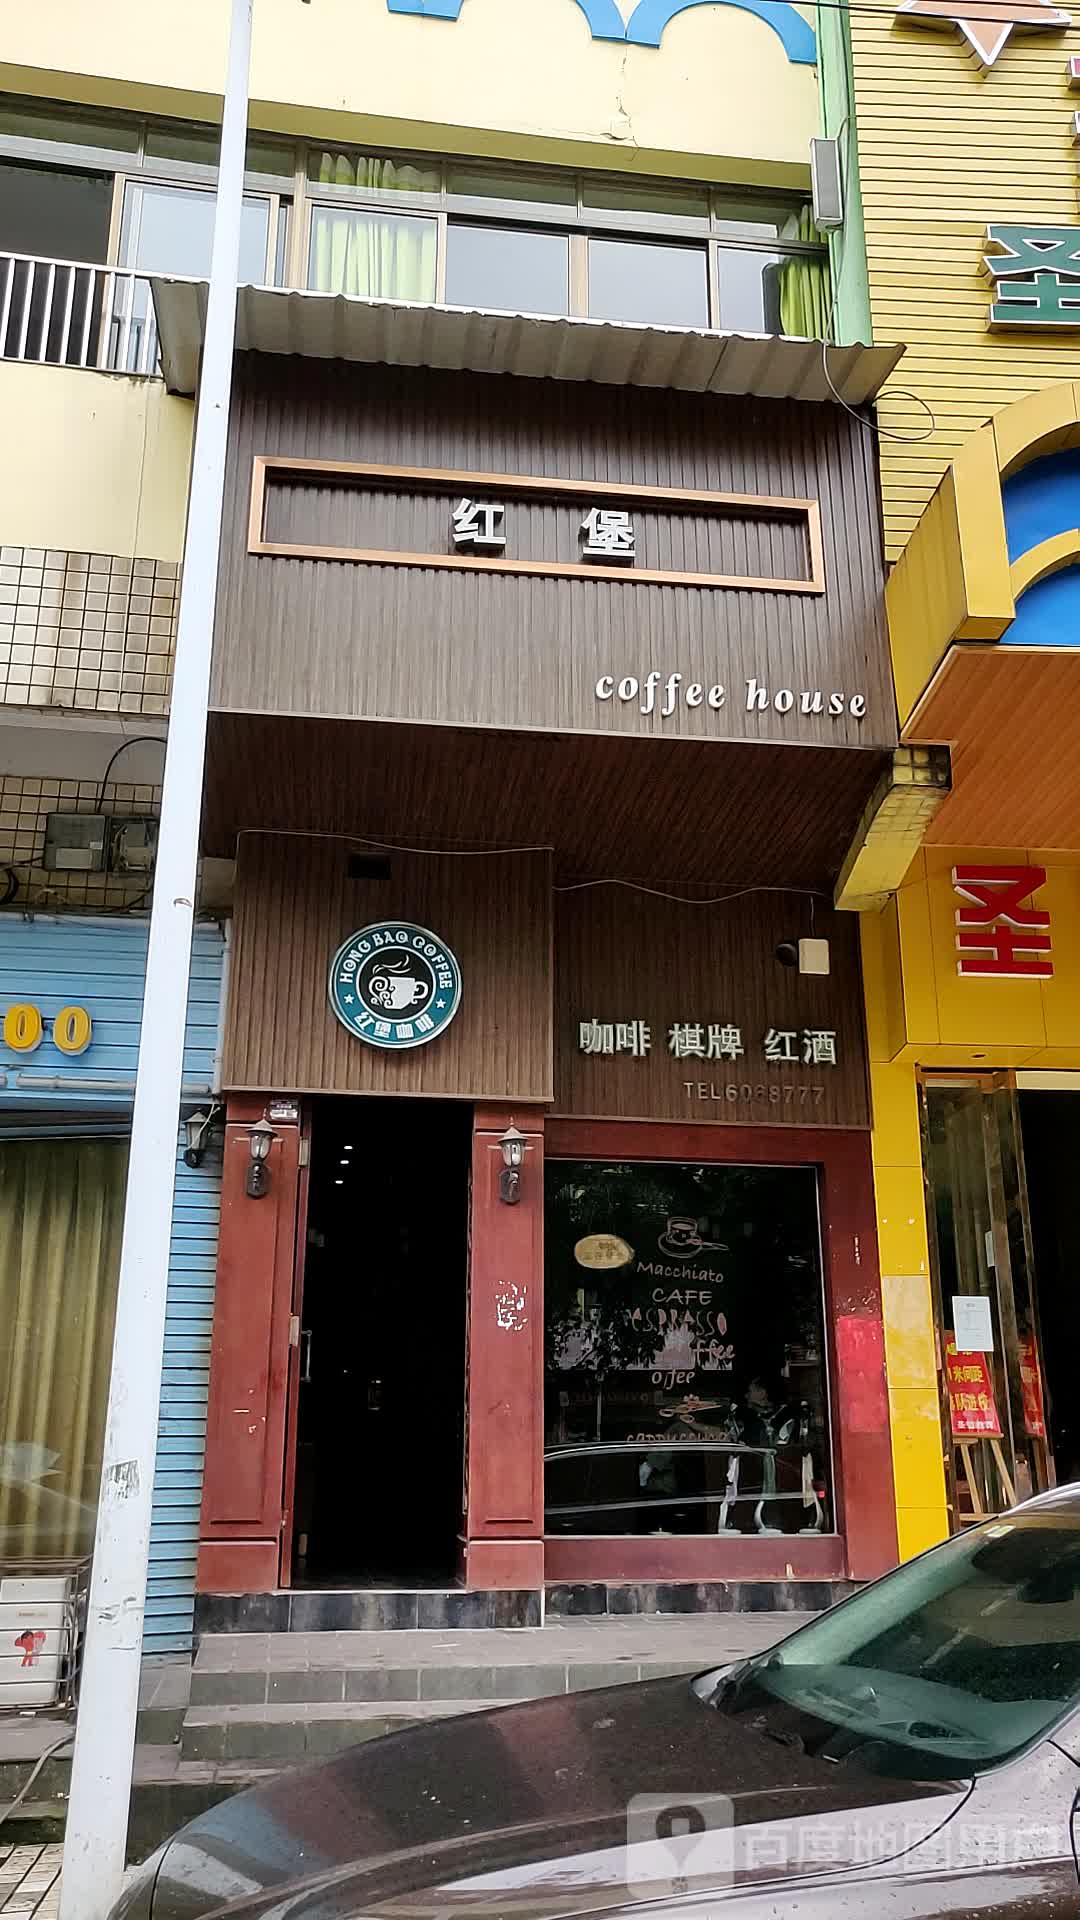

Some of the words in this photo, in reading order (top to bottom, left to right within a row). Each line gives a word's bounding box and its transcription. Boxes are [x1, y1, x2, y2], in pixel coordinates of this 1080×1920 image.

[452, 498, 635, 557] 红堡
[595, 672, 726, 716] coffee
[745, 679, 867, 718] house
[952, 865, 1054, 978] 圣
[340, 940, 372, 984] HONG
[412, 936, 453, 989] COFFEE
[579, 1018, 651, 1056] 咖啡
[668, 1023, 744, 1061] 棋牌
[764, 1028, 837, 1064] 红酒
[637, 1261, 724, 1283] Macchiato
[652, 1288, 713, 1306] CAFE
